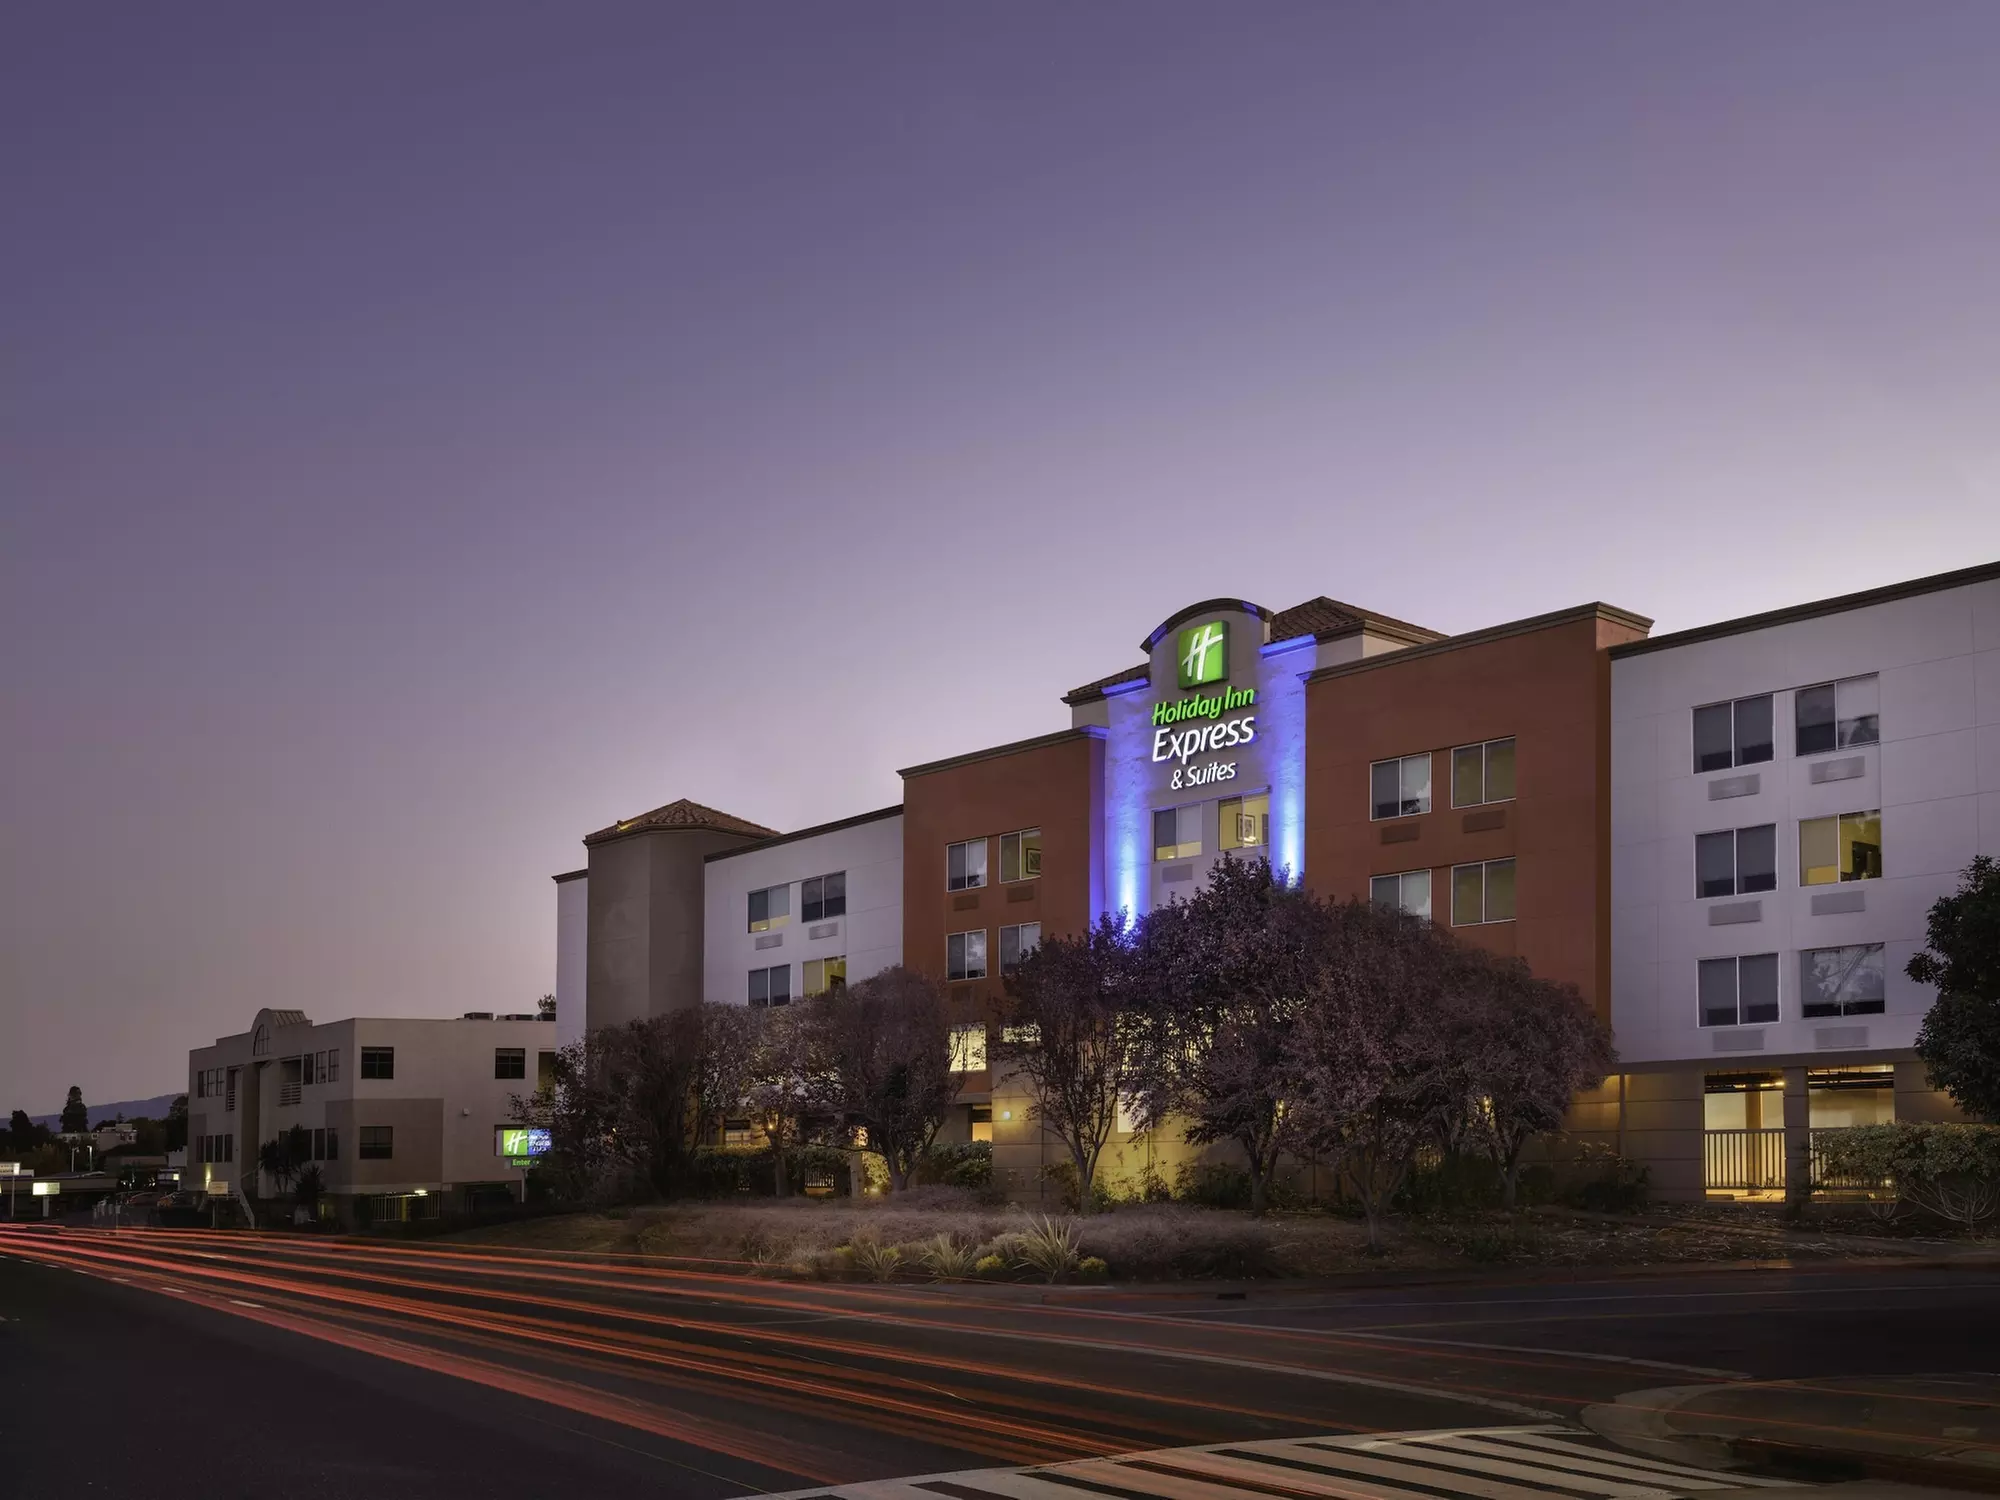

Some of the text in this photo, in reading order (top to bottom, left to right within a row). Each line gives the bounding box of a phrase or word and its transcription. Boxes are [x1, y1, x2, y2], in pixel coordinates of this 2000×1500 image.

[1152, 685, 1255, 726] Holiday Inn
[1152, 716, 1255, 765] Express
[1170, 762, 1237, 790] & Suites
[512, 1158, 531, 1166] Enter
